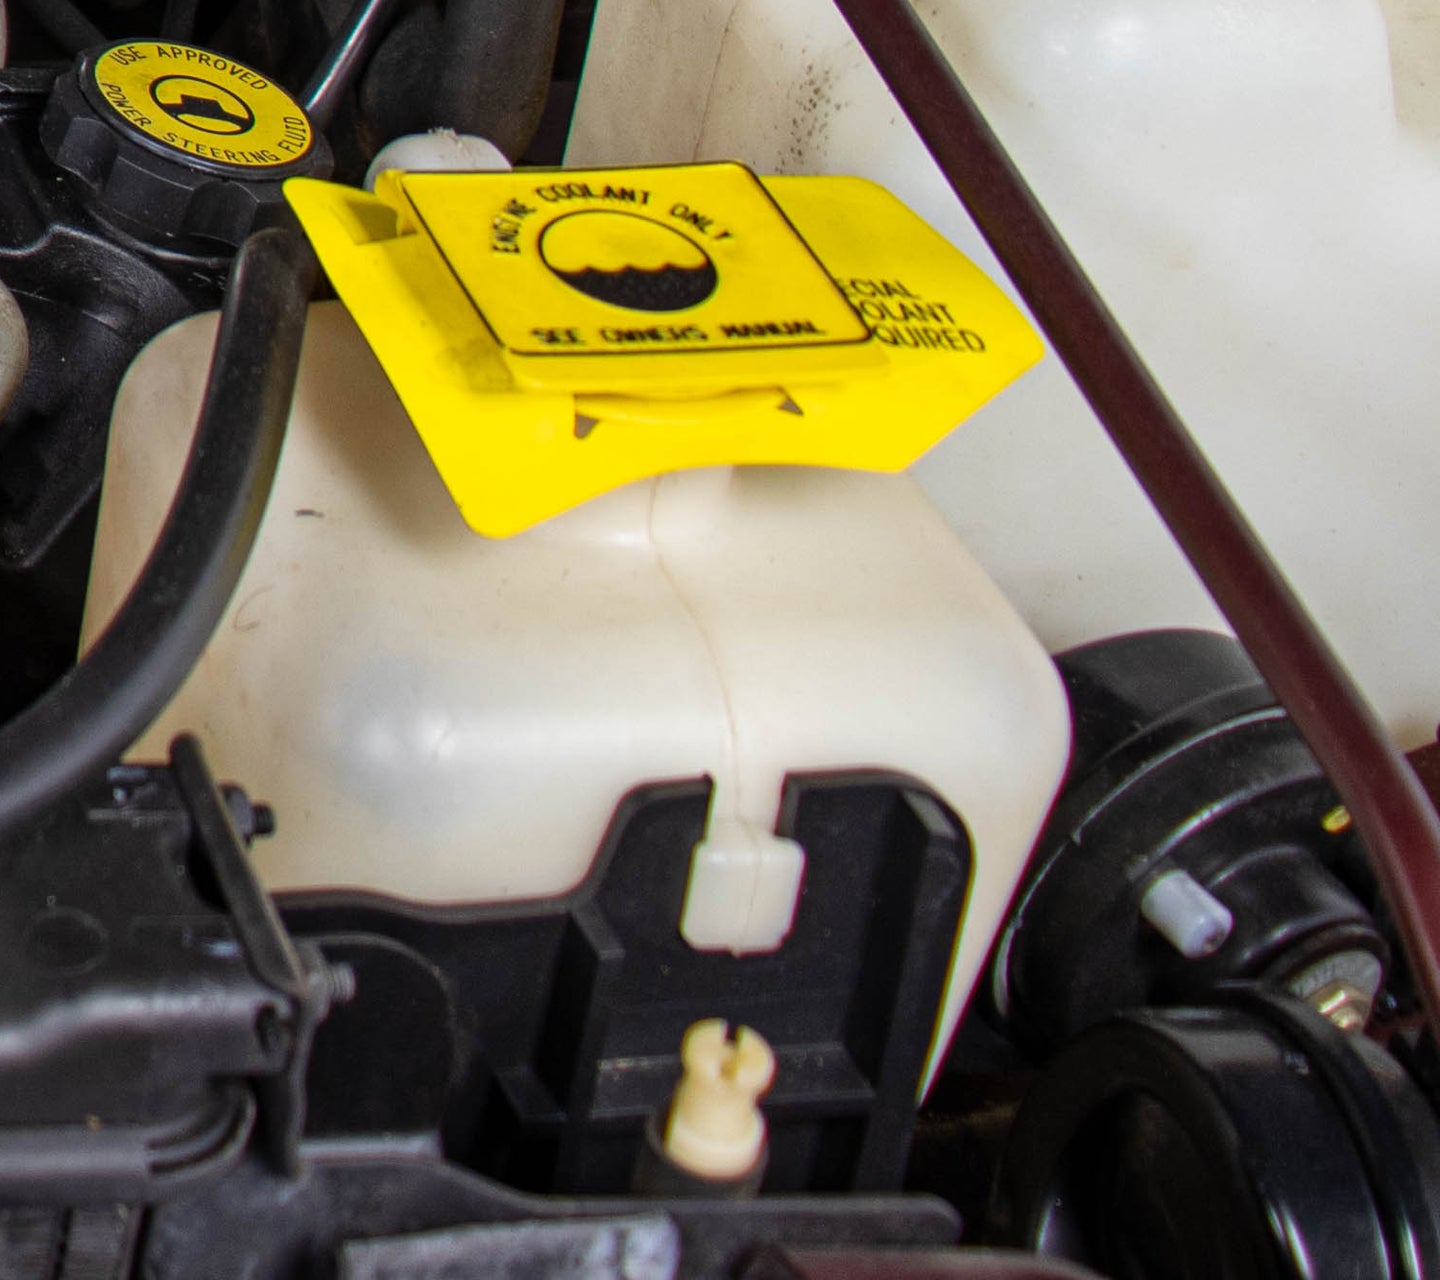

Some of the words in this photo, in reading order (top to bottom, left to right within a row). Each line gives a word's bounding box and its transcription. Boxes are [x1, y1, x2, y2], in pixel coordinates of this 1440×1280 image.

[109, 45, 147, 67] USE
[156, 45, 269, 91] APPROVED
[100, 81, 153, 129] POWER
[162, 131, 281, 164] STEERING
[277, 115, 307, 154] FLUID
[490, 197, 539, 255] ENGINE
[533, 183, 654, 207] COOLANT
[669, 201, 736, 244] ONLY
[848, 278, 921, 300] CIAL
[858, 299, 957, 325] OLANT
[531, 324, 585, 346] SEE
[599, 323, 710, 344] OWNERS
[723, 316, 826, 339] MANUAL
[871, 324, 987, 354] QUIRED
